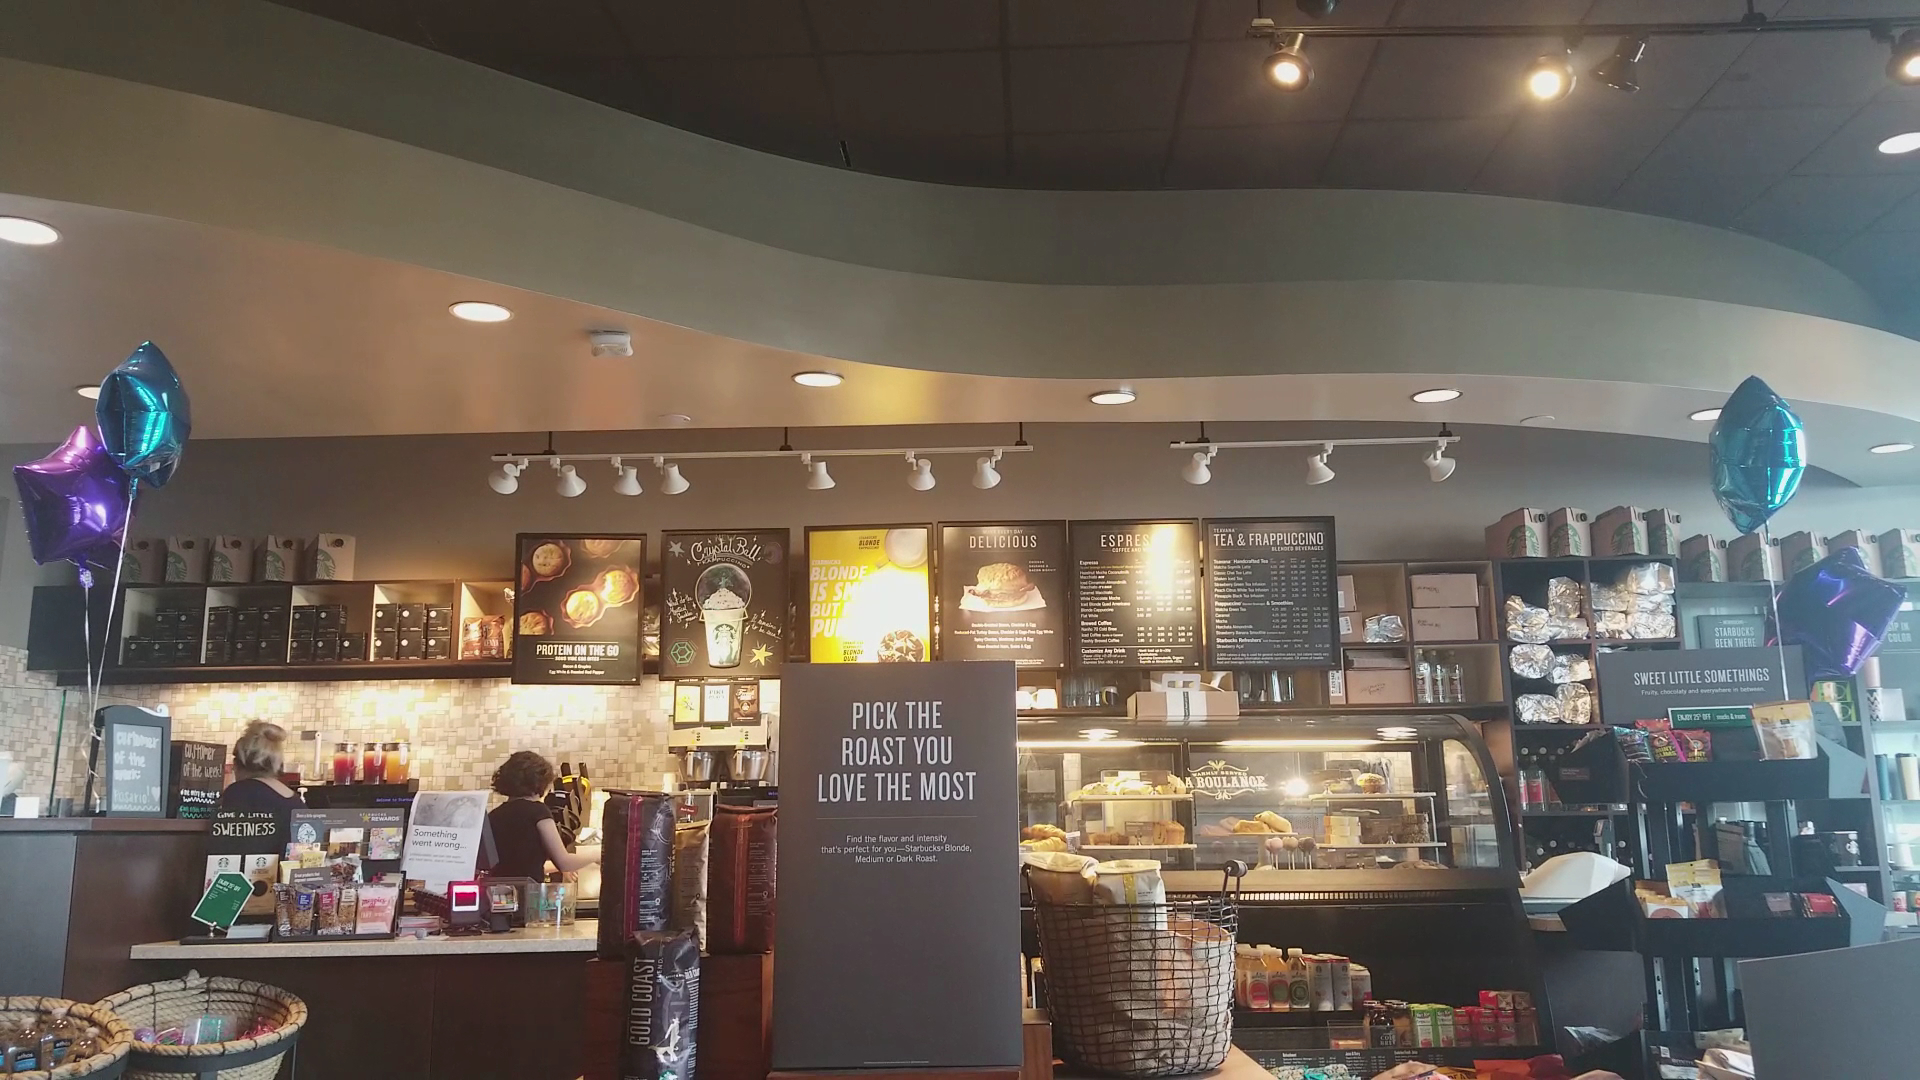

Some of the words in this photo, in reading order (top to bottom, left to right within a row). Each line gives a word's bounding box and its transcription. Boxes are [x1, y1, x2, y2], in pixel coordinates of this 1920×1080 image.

[970, 535, 1037, 548] DELICIOUS
[1101, 534, 1150, 547] ESPRES
[1214, 534, 1233, 546] TEA
[1237, 533, 1245, 546] &
[1249, 532, 1324, 546] FRAPPUCCINO
[691, 538, 732, 561] Crystal
[732, 537, 761, 561] Ball
[811, 566, 868, 580] BLONDE
[811, 582, 828, 601] IS
[811, 602, 840, 617] BUT
[1715, 627, 1754, 636] STARBUCKS
[1888, 633, 1912, 642] COLOR
[1715, 638, 1733, 647] BEEN
[1735, 638, 1756, 647] THERE
[536, 645, 572, 655] PROTEIN
[574, 645, 586, 655] ON
[589, 645, 605, 656] THE
[607, 645, 619, 656] GO
[1634, 671, 1666, 686] SWEET
[1670, 670, 1701, 685] LITTLE
[1704, 668, 1770, 684] SOMETHINGS
[1700, 687, 1731, 695] everywhere
[852, 702, 898, 729] PICK
[905, 701, 942, 729] THE
[184, 743, 216, 762] customer
[842, 737, 906, 766] ROAST
[913, 736, 952, 765] YOU
[114, 752, 126, 766] of
[128, 750, 146, 768] the
[182, 764, 190, 777] of
[191, 765, 203, 778] the
[205, 764, 222, 778] week!
[818, 774, 866, 802] LOVE
[875, 773, 911, 801] THE
[920, 772, 976, 800] MOST
[1196, 775, 1268, 788] BOULANGE
[114, 786, 150, 804] Rosario!
[213, 823, 276, 837] SWEETNESS
[414, 829, 458, 840] Something
[434, 841, 467, 850] wrong...
[917, 834, 947, 843] intensity
[844, 845, 869, 854] perfect
[872, 845, 882, 853] for
[945, 844, 972, 852] Blonde,
[855, 855, 884, 863] Medium
[631, 956, 656, 1002] COAST
[629, 1006, 651, 1047] GOLD
